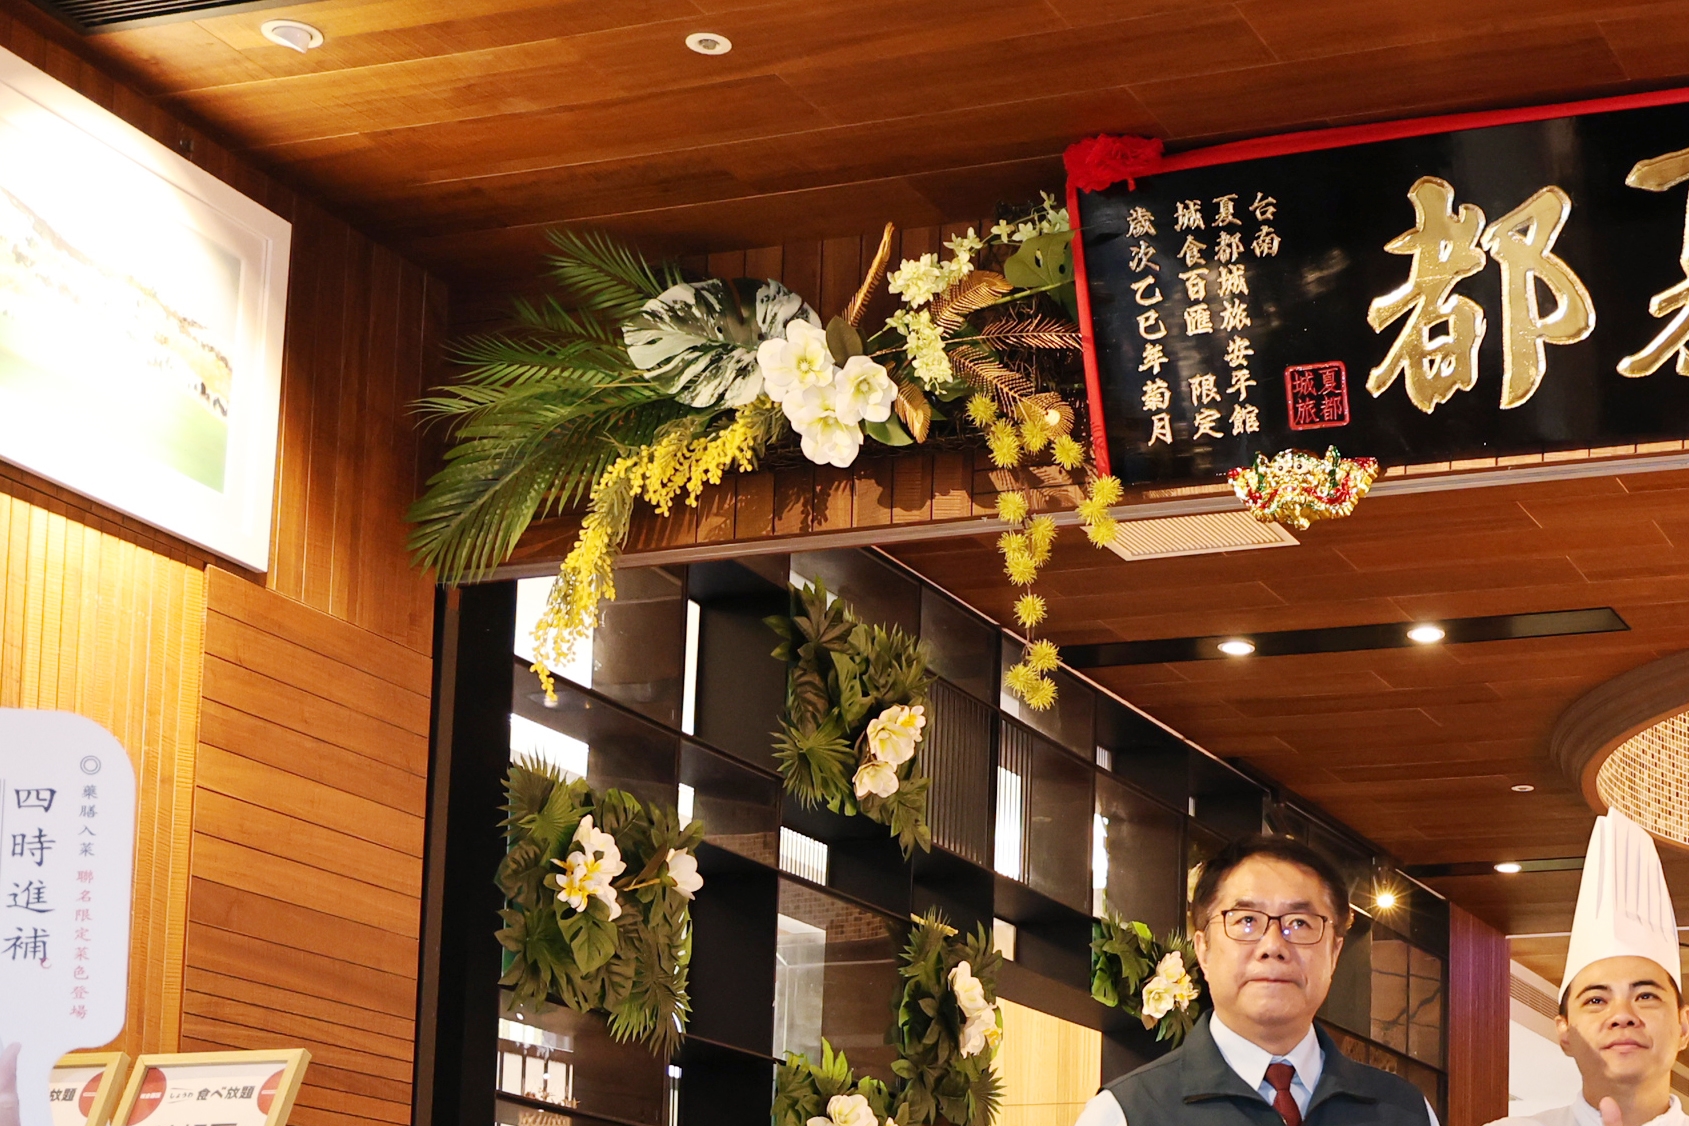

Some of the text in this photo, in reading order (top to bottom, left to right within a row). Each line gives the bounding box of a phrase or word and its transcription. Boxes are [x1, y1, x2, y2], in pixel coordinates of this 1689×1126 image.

[1249, 192, 1281, 258] 台南
[1174, 200, 1224, 440] 城食百匯 限定
[4, 788, 57, 962] 四時進補
[197, 1086, 256, 1101] 食べ放題
